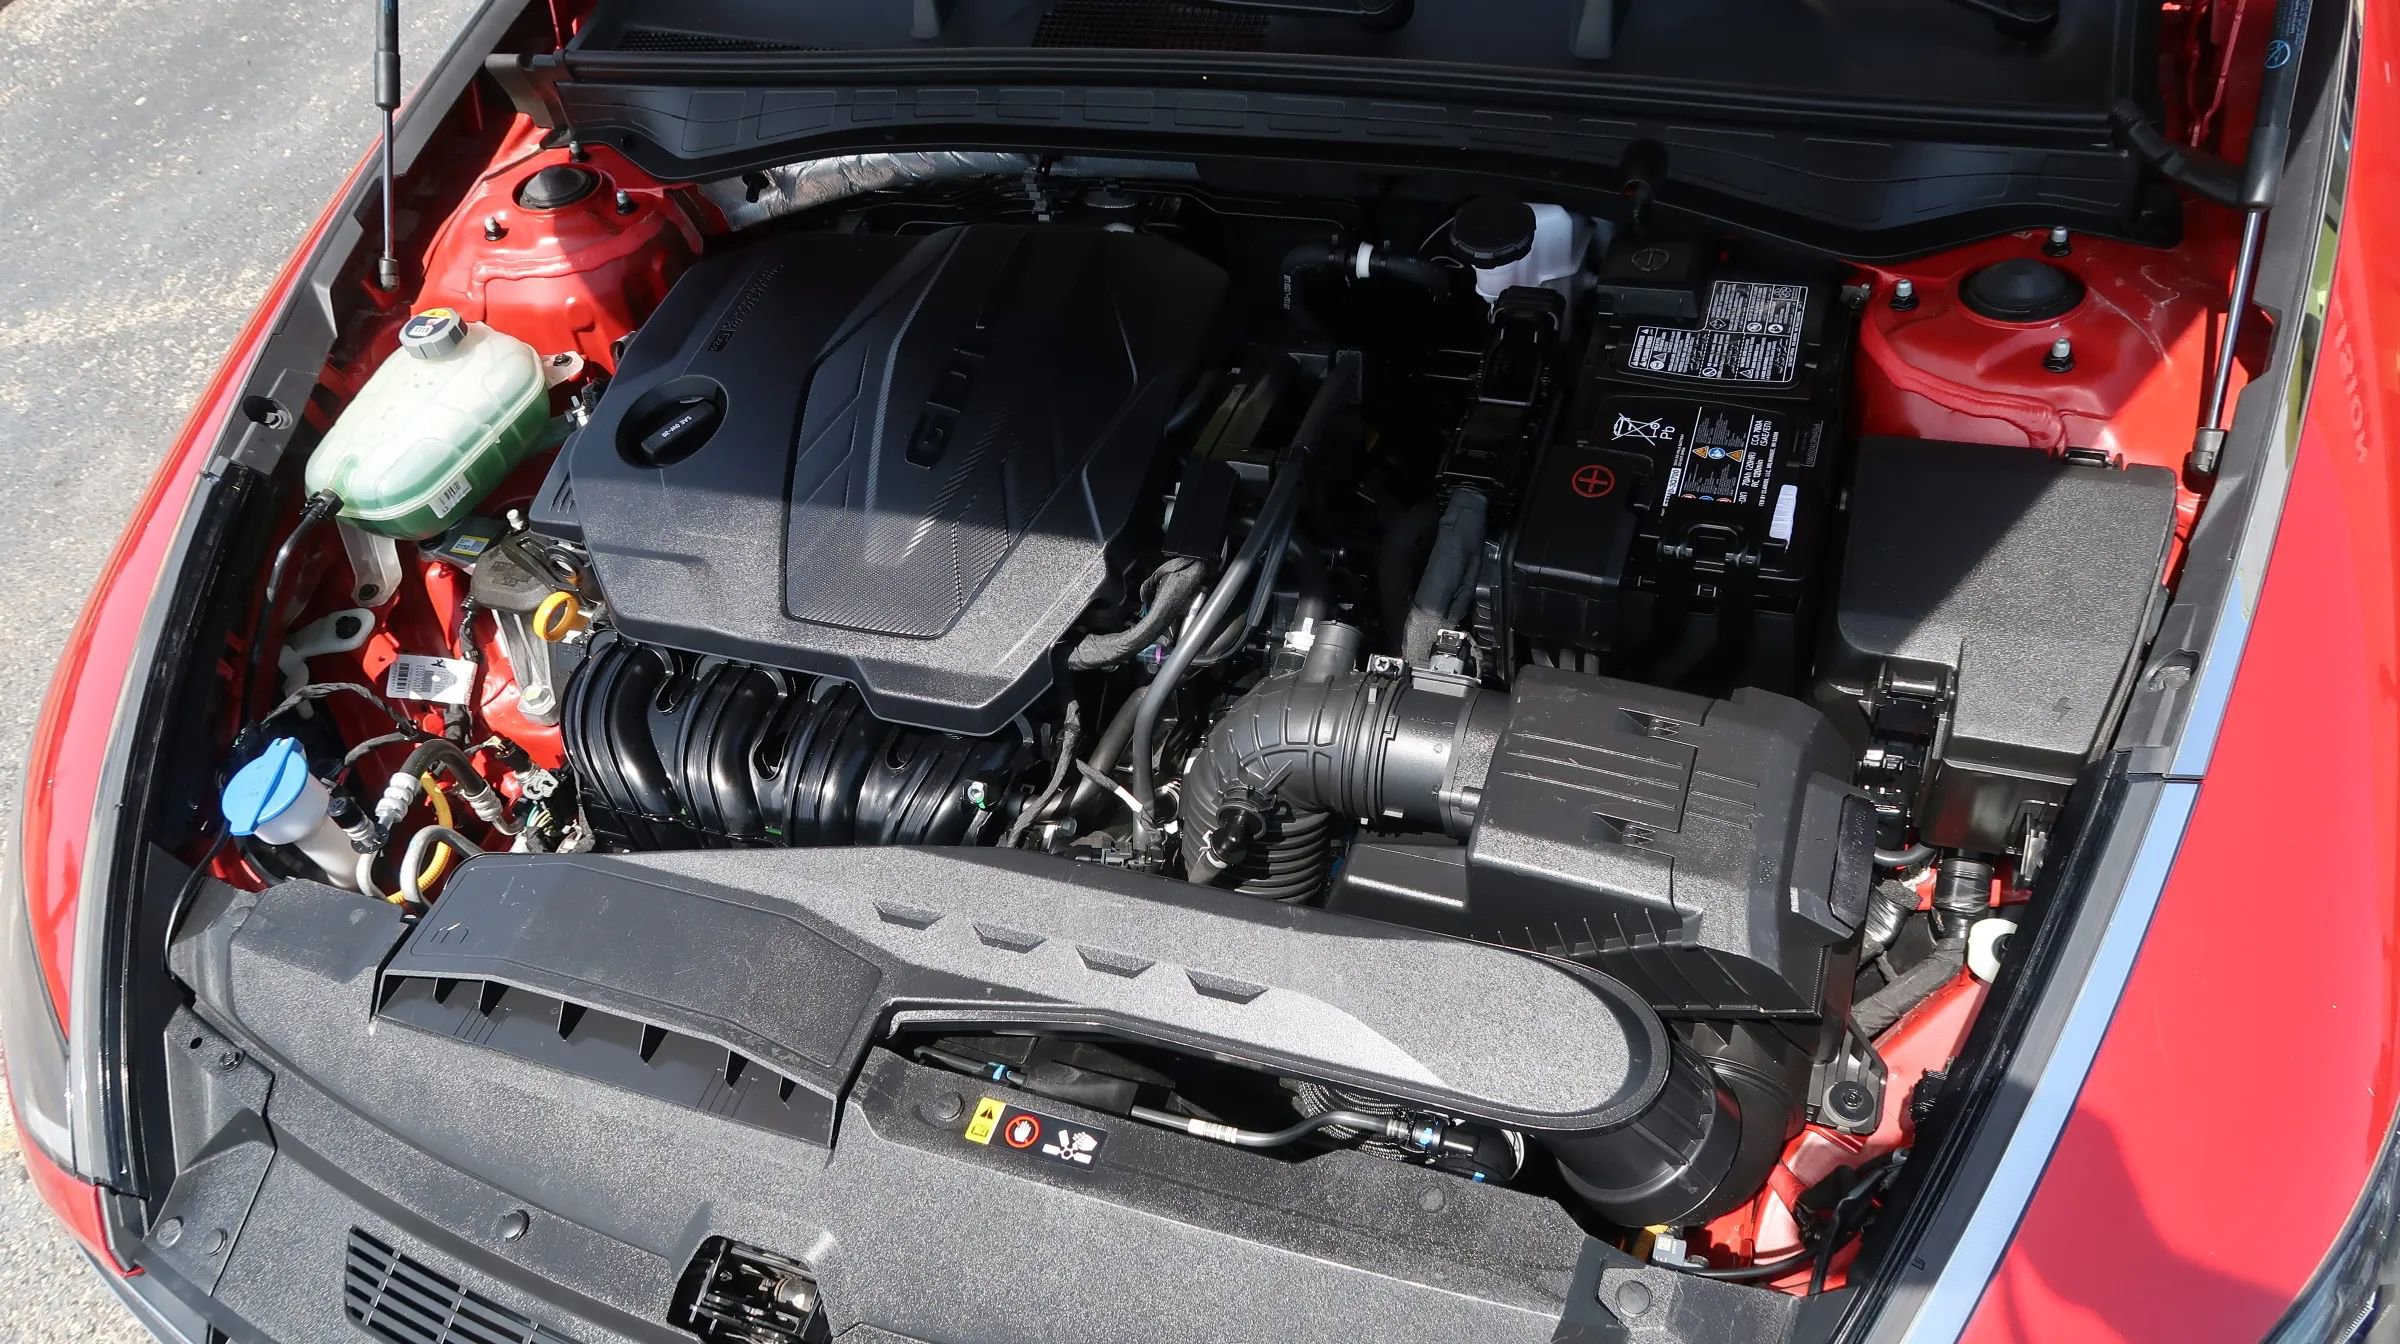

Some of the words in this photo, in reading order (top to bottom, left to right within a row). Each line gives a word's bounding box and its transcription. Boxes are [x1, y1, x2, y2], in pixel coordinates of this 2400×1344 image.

[679, 415, 692, 425] SAE
[1660, 425, 1675, 439] Pb
[1751, 434, 1760, 446] CCA
[1745, 451, 1757, 471] (20HR)
[1753, 460, 1764, 478] 120min
[1742, 472, 1752, 487] 70Ah
[1751, 479, 1760, 488] RC
